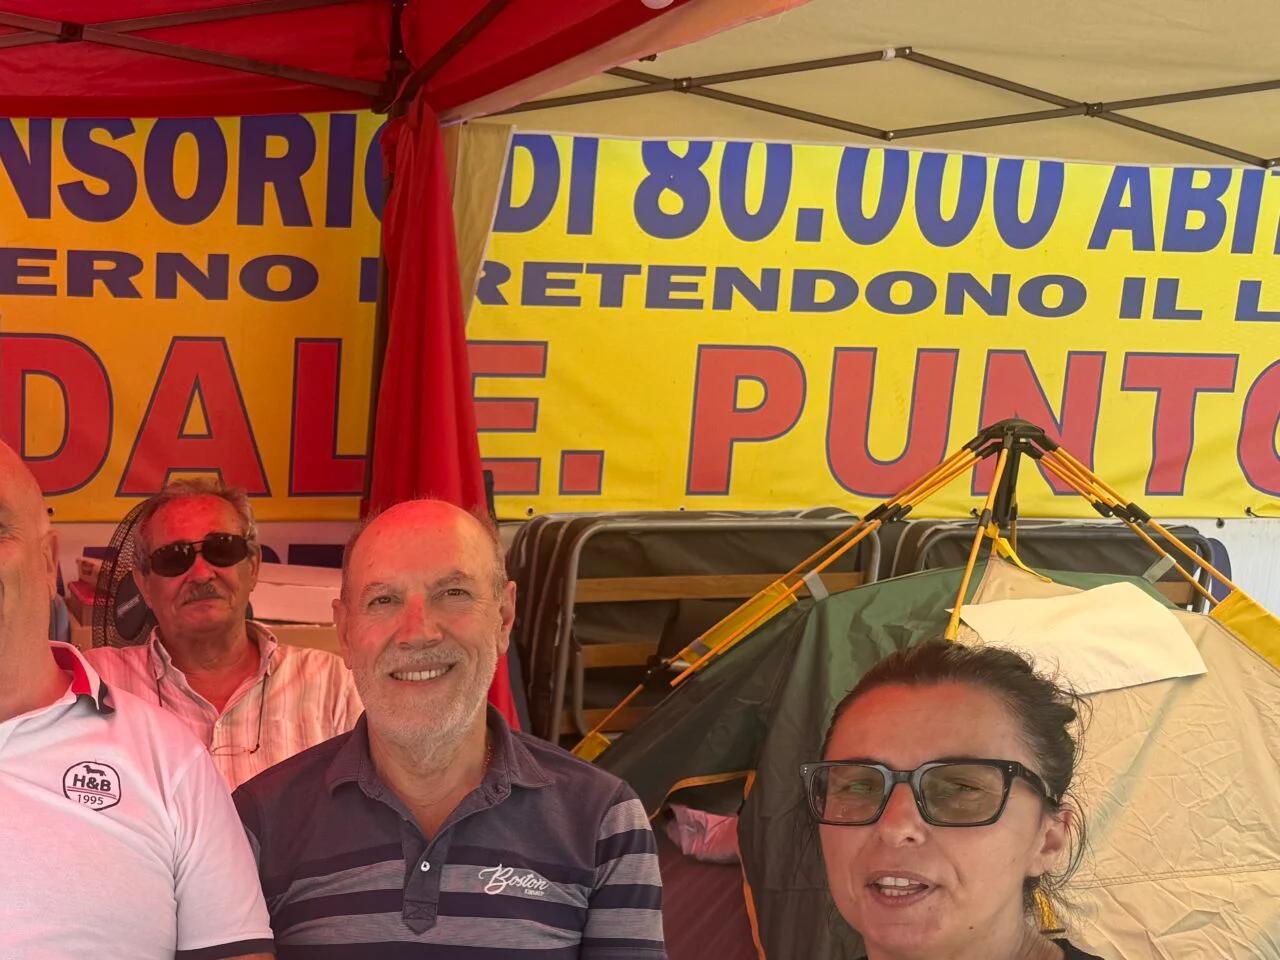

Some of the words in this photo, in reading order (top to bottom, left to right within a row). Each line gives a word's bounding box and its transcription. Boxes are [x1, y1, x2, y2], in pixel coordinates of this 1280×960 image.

[491, 133, 599, 236] DI
[633, 140, 1065, 250] 80.000
[1086, 165, 1280, 256] ABI
[1119, 276, 1203, 320] IL
[72, 773, 112, 792] H&B
[78, 794, 104, 806] 1995
[478, 863, 550, 895] Boston
